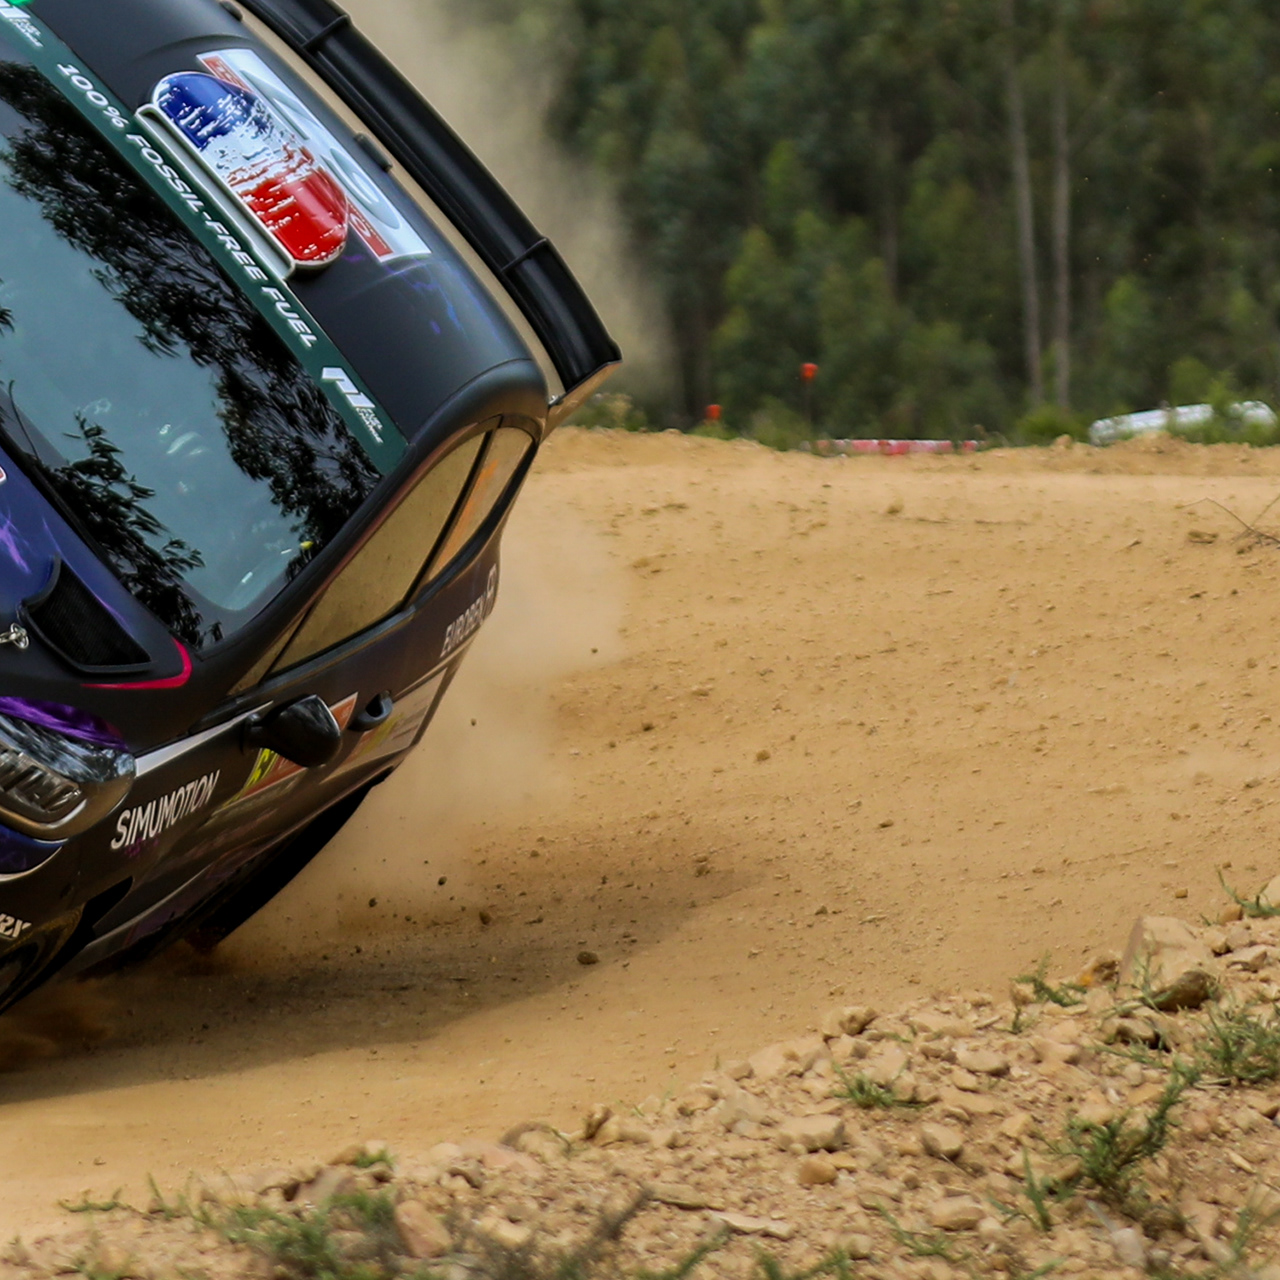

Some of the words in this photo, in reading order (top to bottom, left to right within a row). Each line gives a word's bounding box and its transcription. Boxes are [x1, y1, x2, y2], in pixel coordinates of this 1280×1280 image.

[56, 63, 129, 129] 100%
[126, 133, 269, 281] FOSSIL-FREE
[261, 285, 318, 348] FUEL
[110, 769, 220, 850] SIMUMOTION
